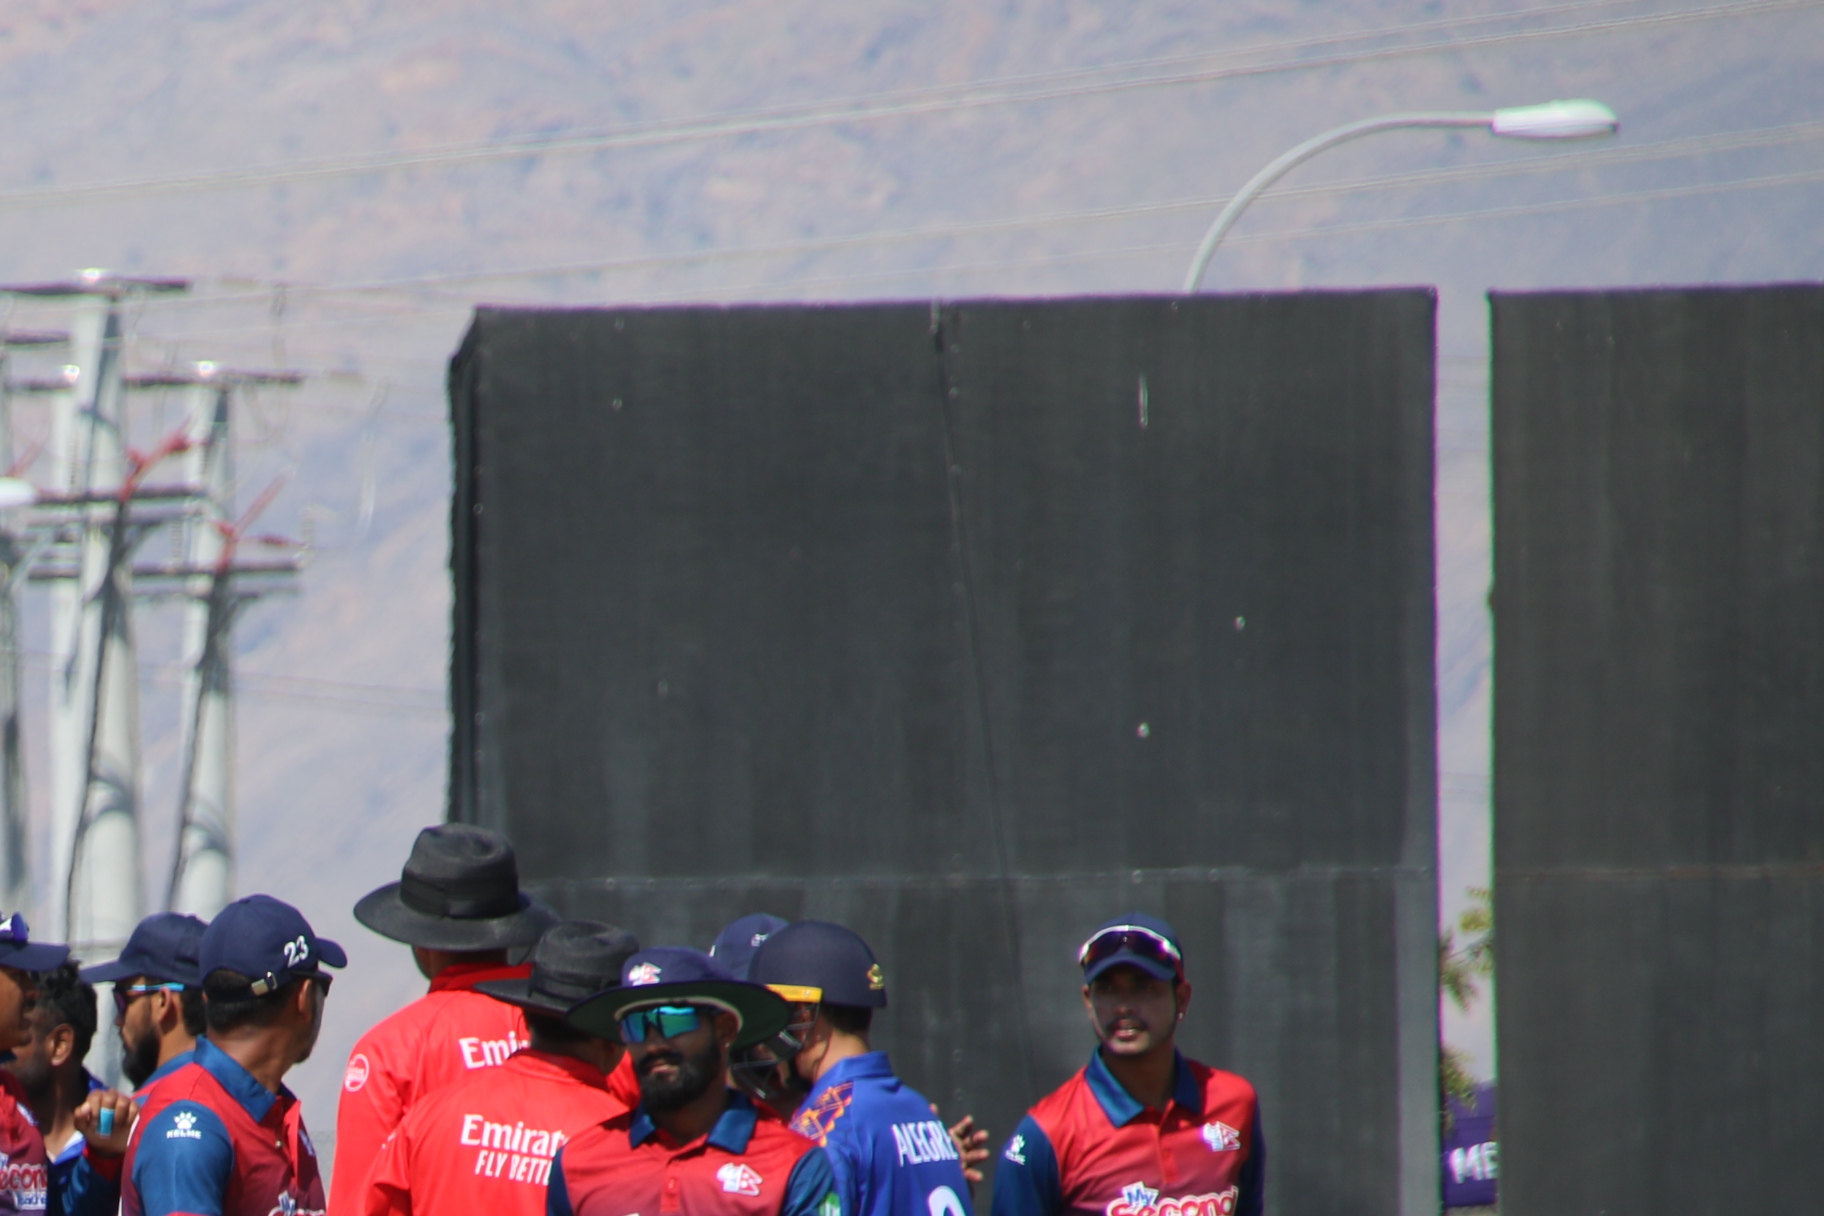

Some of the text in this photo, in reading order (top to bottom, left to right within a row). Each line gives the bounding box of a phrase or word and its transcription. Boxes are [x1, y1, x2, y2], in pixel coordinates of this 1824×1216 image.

[284, 935, 309, 968] 23
[460, 1114, 570, 1158] Emirat
[474, 1149, 554, 1187] FLY BETT
[1126, 1188, 1155, 1206] My
